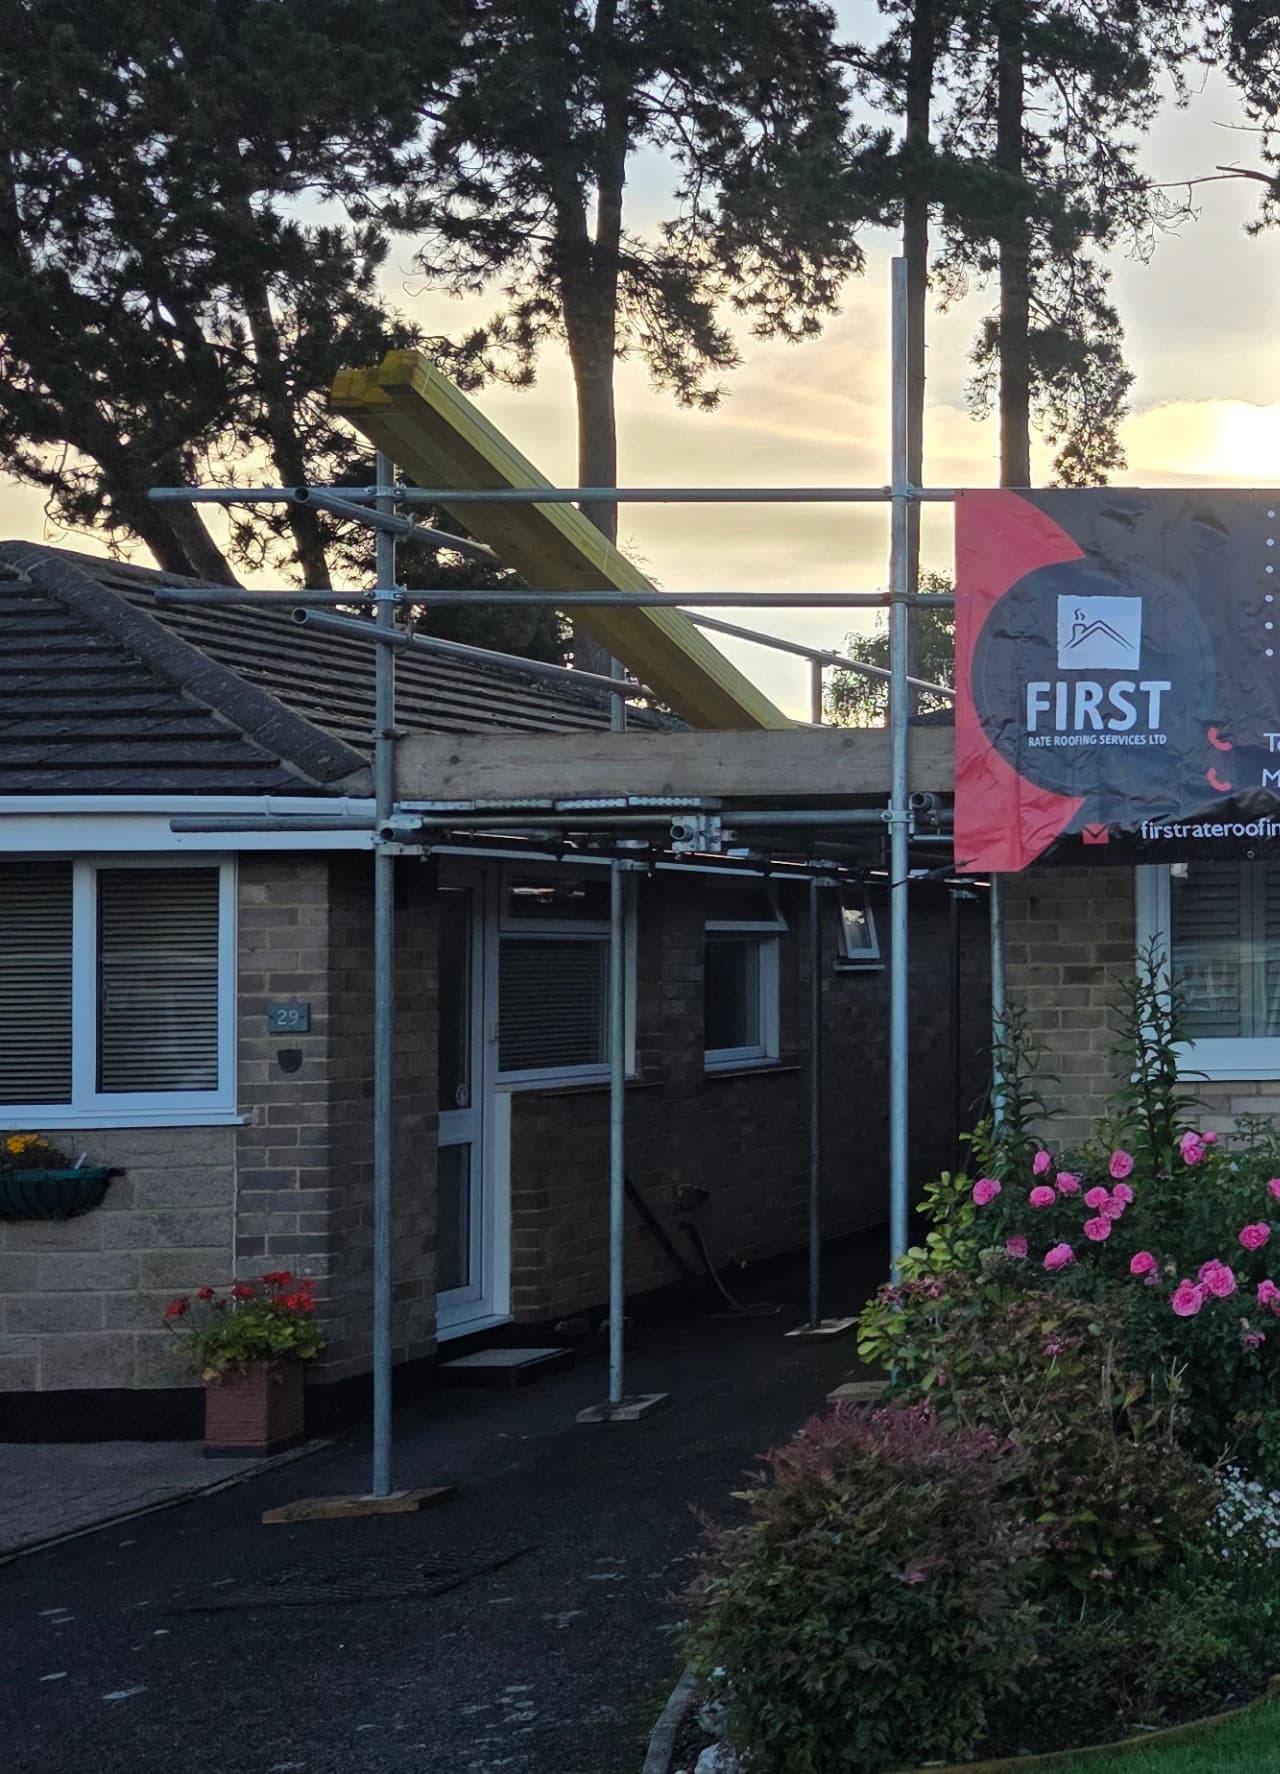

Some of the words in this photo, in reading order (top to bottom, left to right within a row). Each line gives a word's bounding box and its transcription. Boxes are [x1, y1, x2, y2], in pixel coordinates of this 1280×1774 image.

[1026, 680, 1172, 732] FIRST
[1028, 735, 1052, 747] RATE
[1054, 734, 1097, 746] ROOFING
[1099, 734, 1146, 745] SERVICES
[1149, 734, 1167, 745] LTD
[277, 1010, 299, 1026] 29
